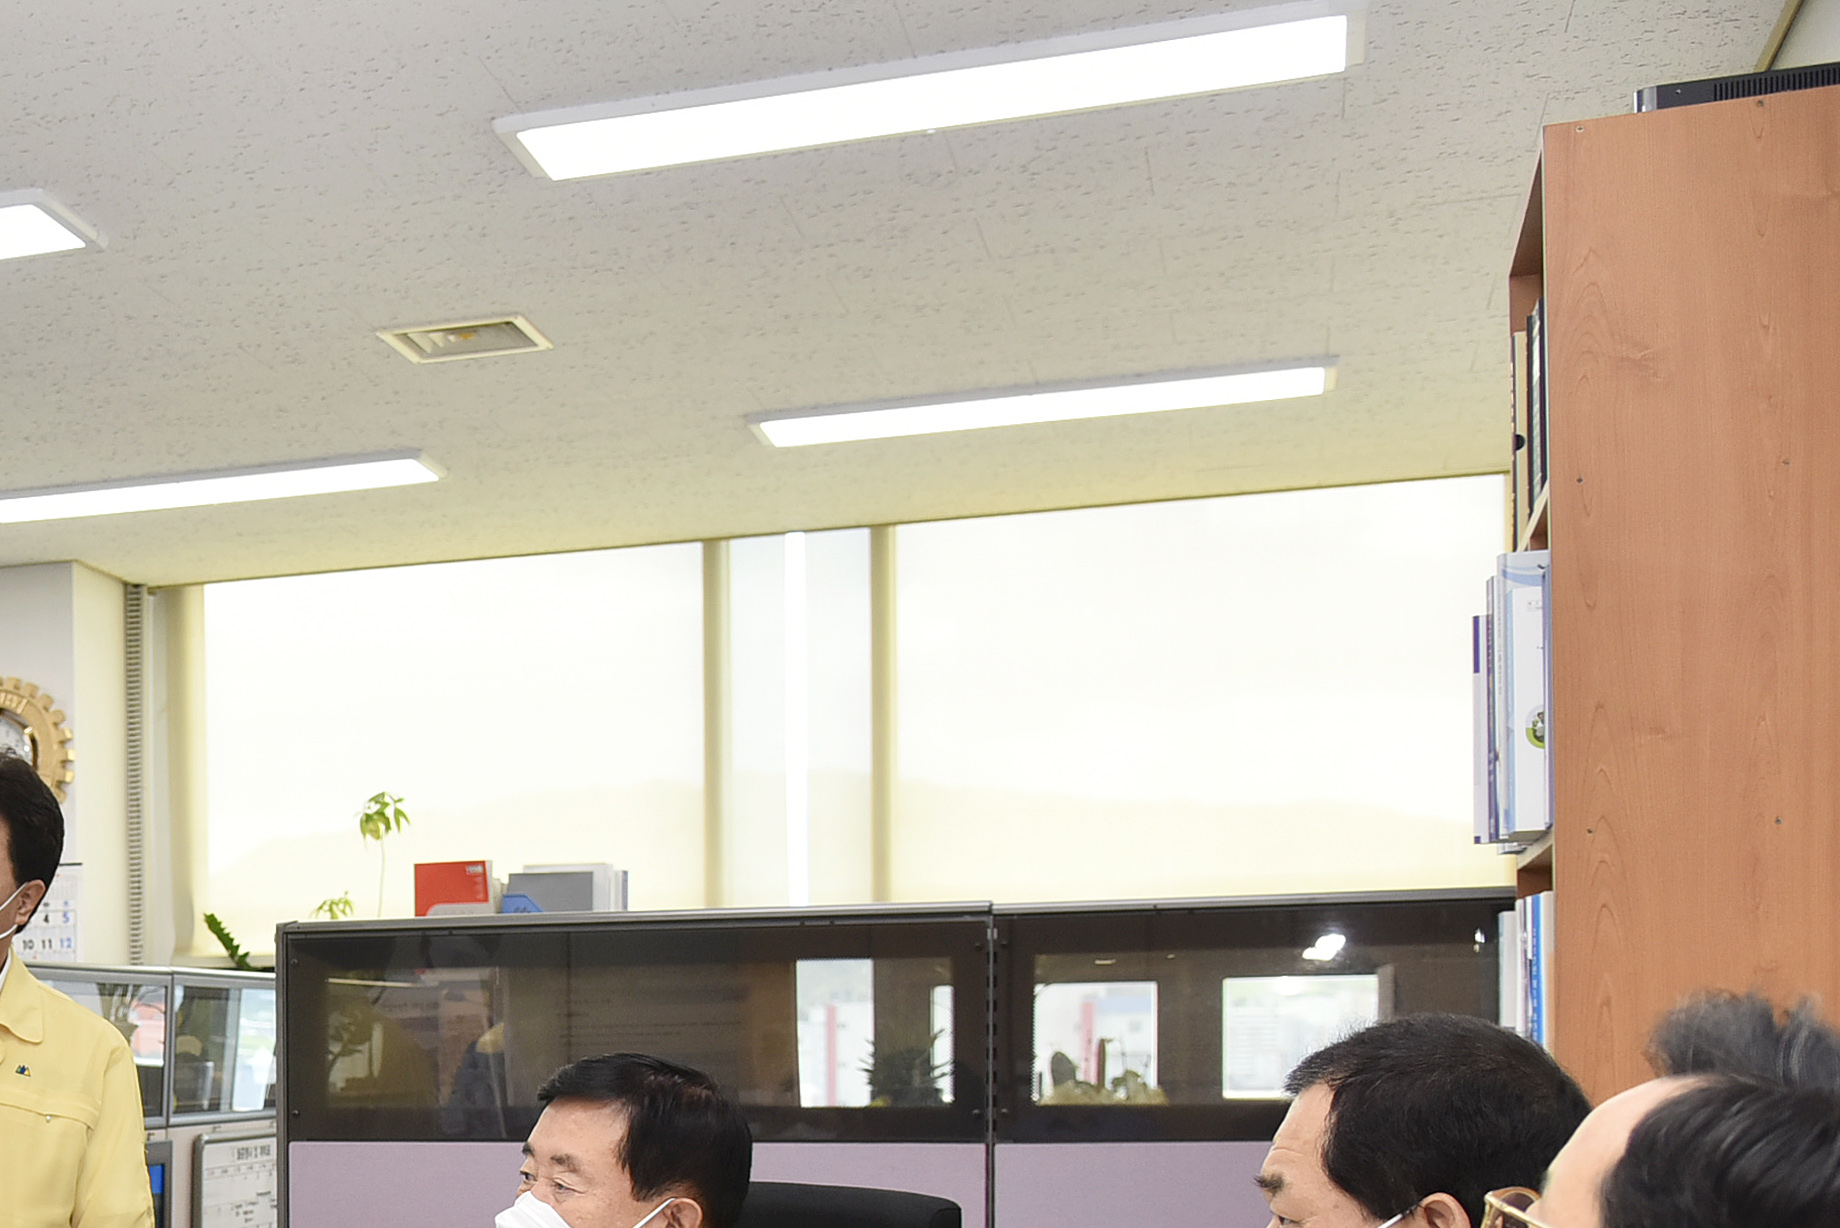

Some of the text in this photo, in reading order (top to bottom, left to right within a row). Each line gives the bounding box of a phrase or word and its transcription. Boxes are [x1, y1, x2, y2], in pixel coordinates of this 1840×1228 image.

[43, 912, 69, 923] 4 5
[23, 938, 72, 949] 10 11 12
